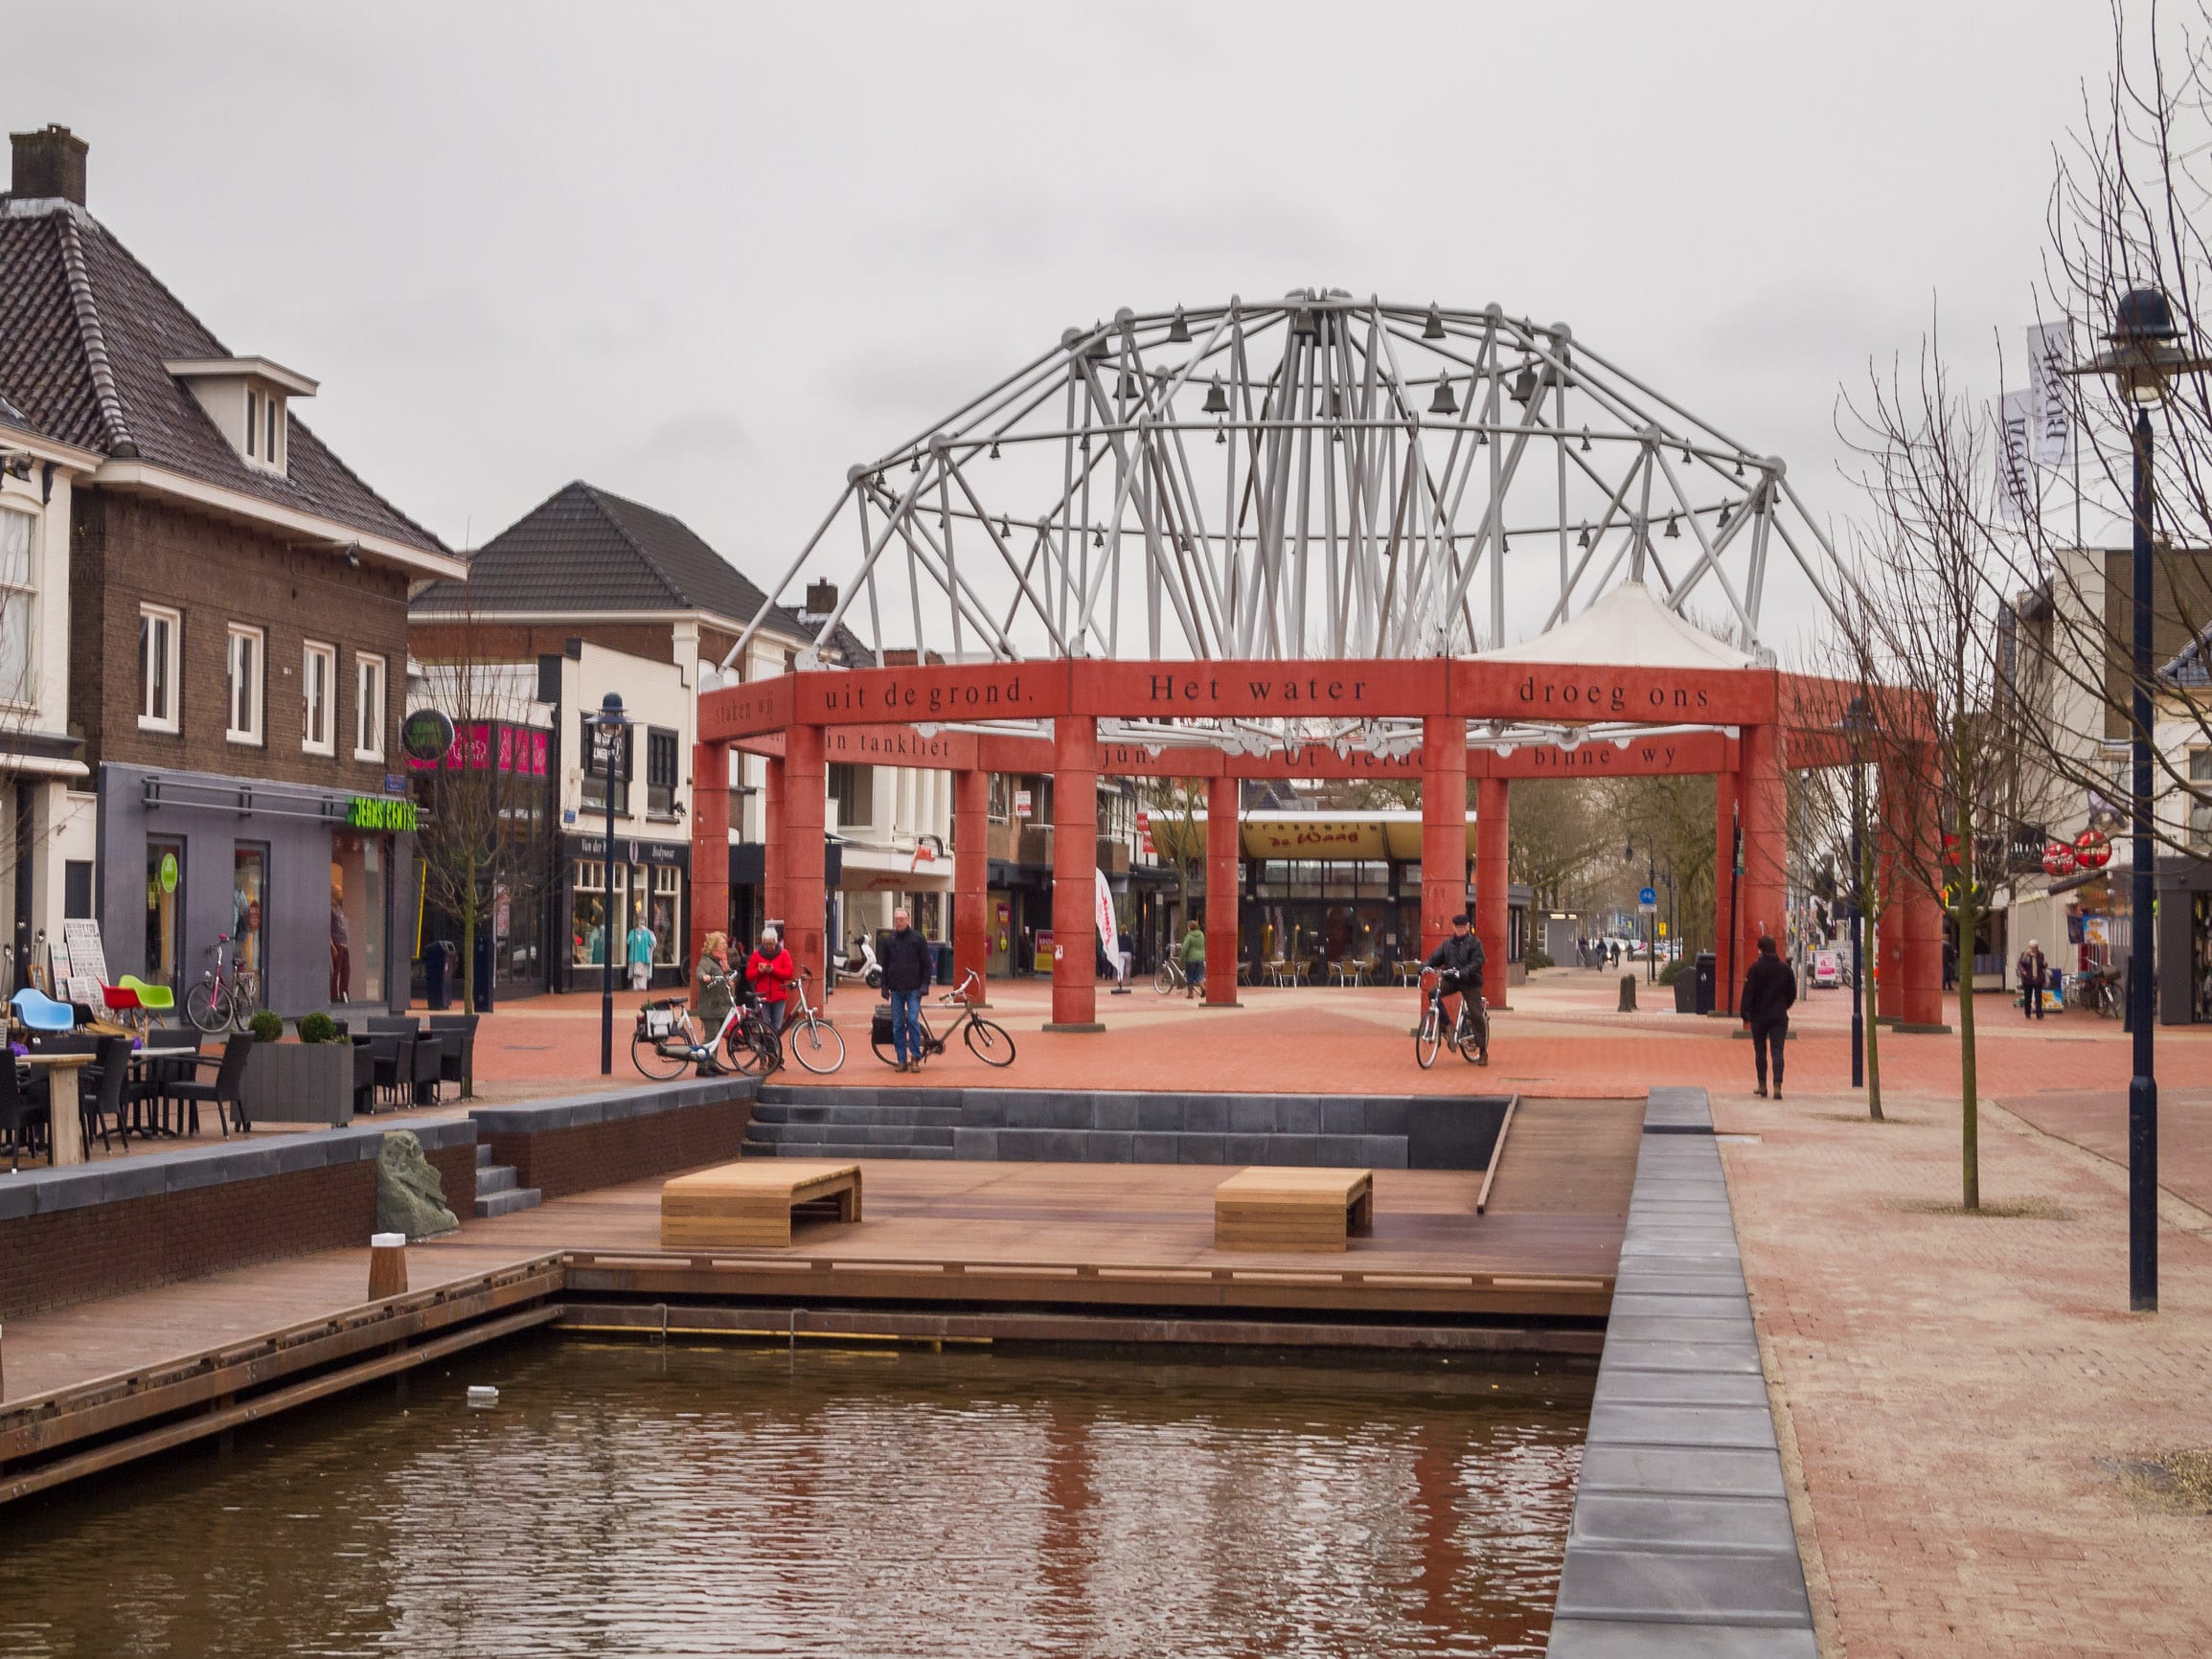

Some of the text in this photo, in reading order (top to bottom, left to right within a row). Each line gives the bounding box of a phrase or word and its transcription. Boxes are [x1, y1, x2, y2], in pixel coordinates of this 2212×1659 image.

[825, 676, 1034, 713] uit de grond.
[1150, 674, 1367, 702] Het water
[1519, 676, 1709, 712] droeg ons
[859, 733, 950, 759] tankliet
[1534, 746, 1677, 768] binne wy
[354, 796, 419, 832] JEANS CENTRE
[1296, 831, 1359, 846] Waag
